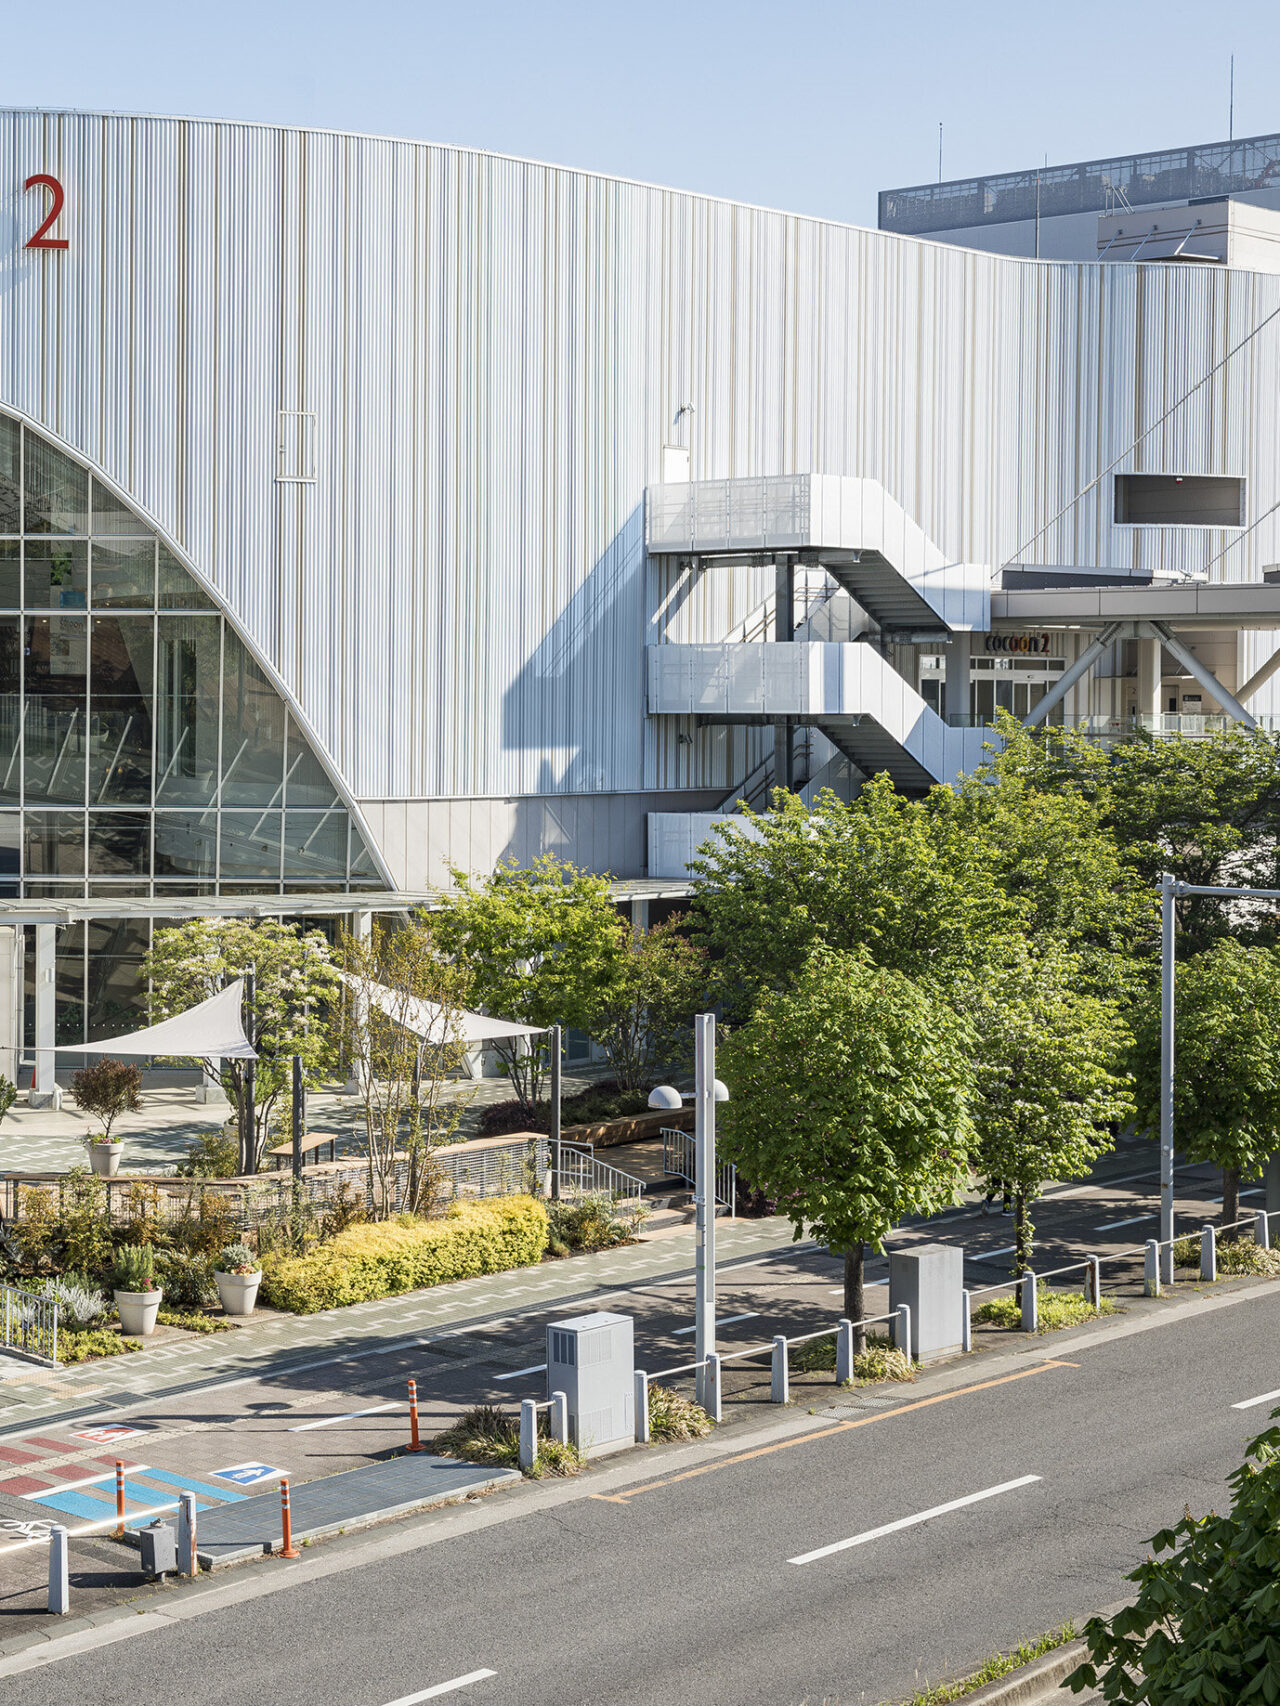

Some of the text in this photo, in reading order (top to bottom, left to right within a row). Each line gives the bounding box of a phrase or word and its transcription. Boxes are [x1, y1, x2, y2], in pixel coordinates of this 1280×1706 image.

[24, 174, 69, 250] 2
[985, 633, 1050, 653] cocoon 2
